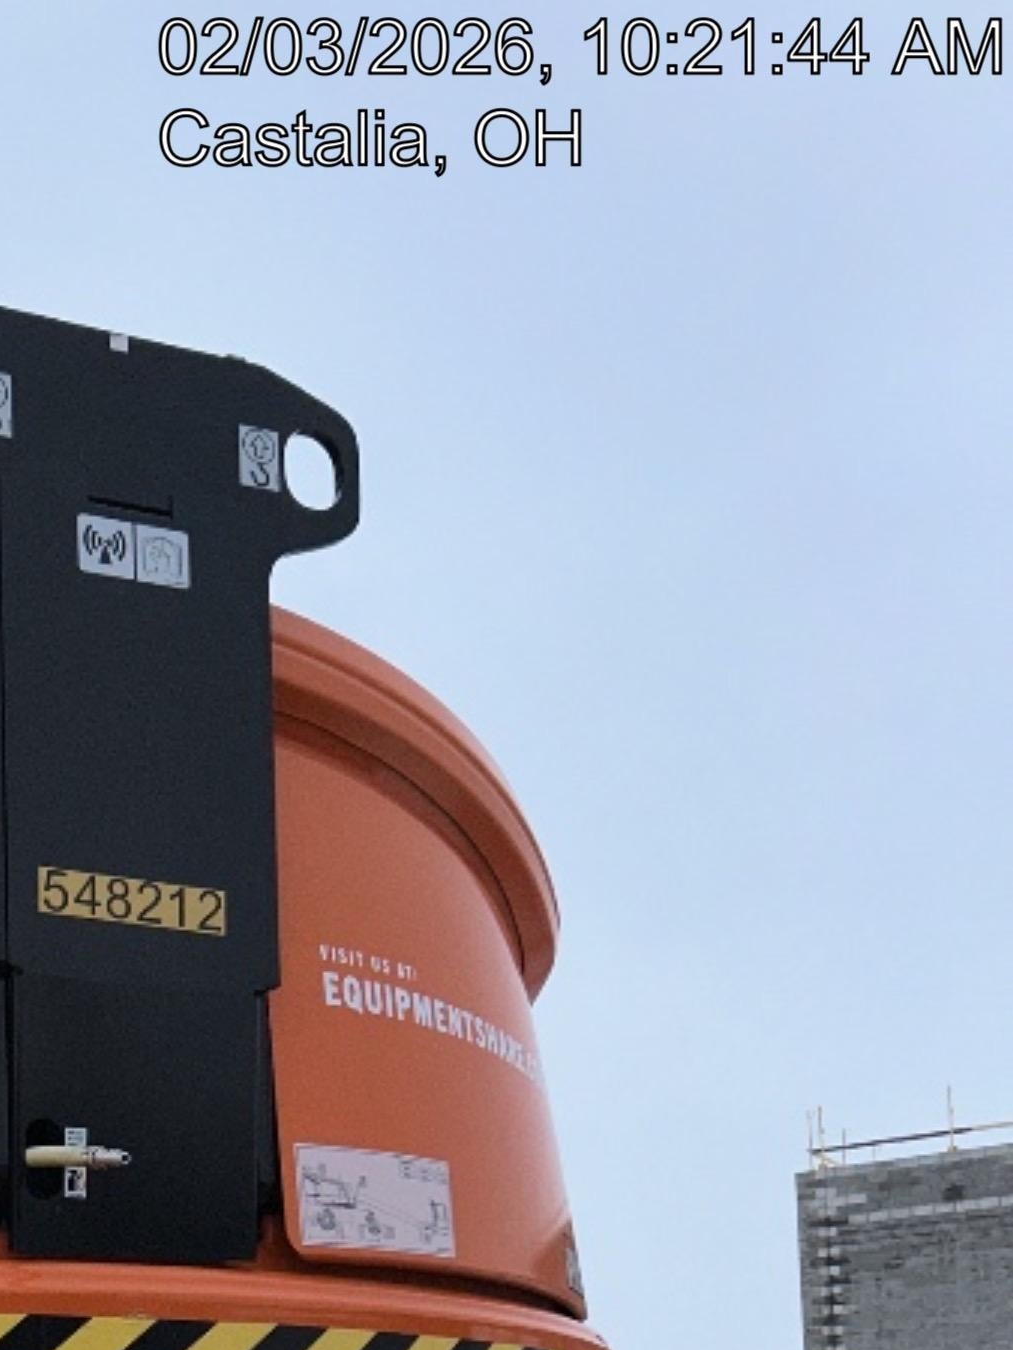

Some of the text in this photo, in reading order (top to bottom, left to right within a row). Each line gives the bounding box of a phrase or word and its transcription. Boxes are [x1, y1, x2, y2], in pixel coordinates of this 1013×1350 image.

[44, 868, 223, 933] 548212
[319, 944, 363, 967] VISIT
[370, 955, 390, 974] US
